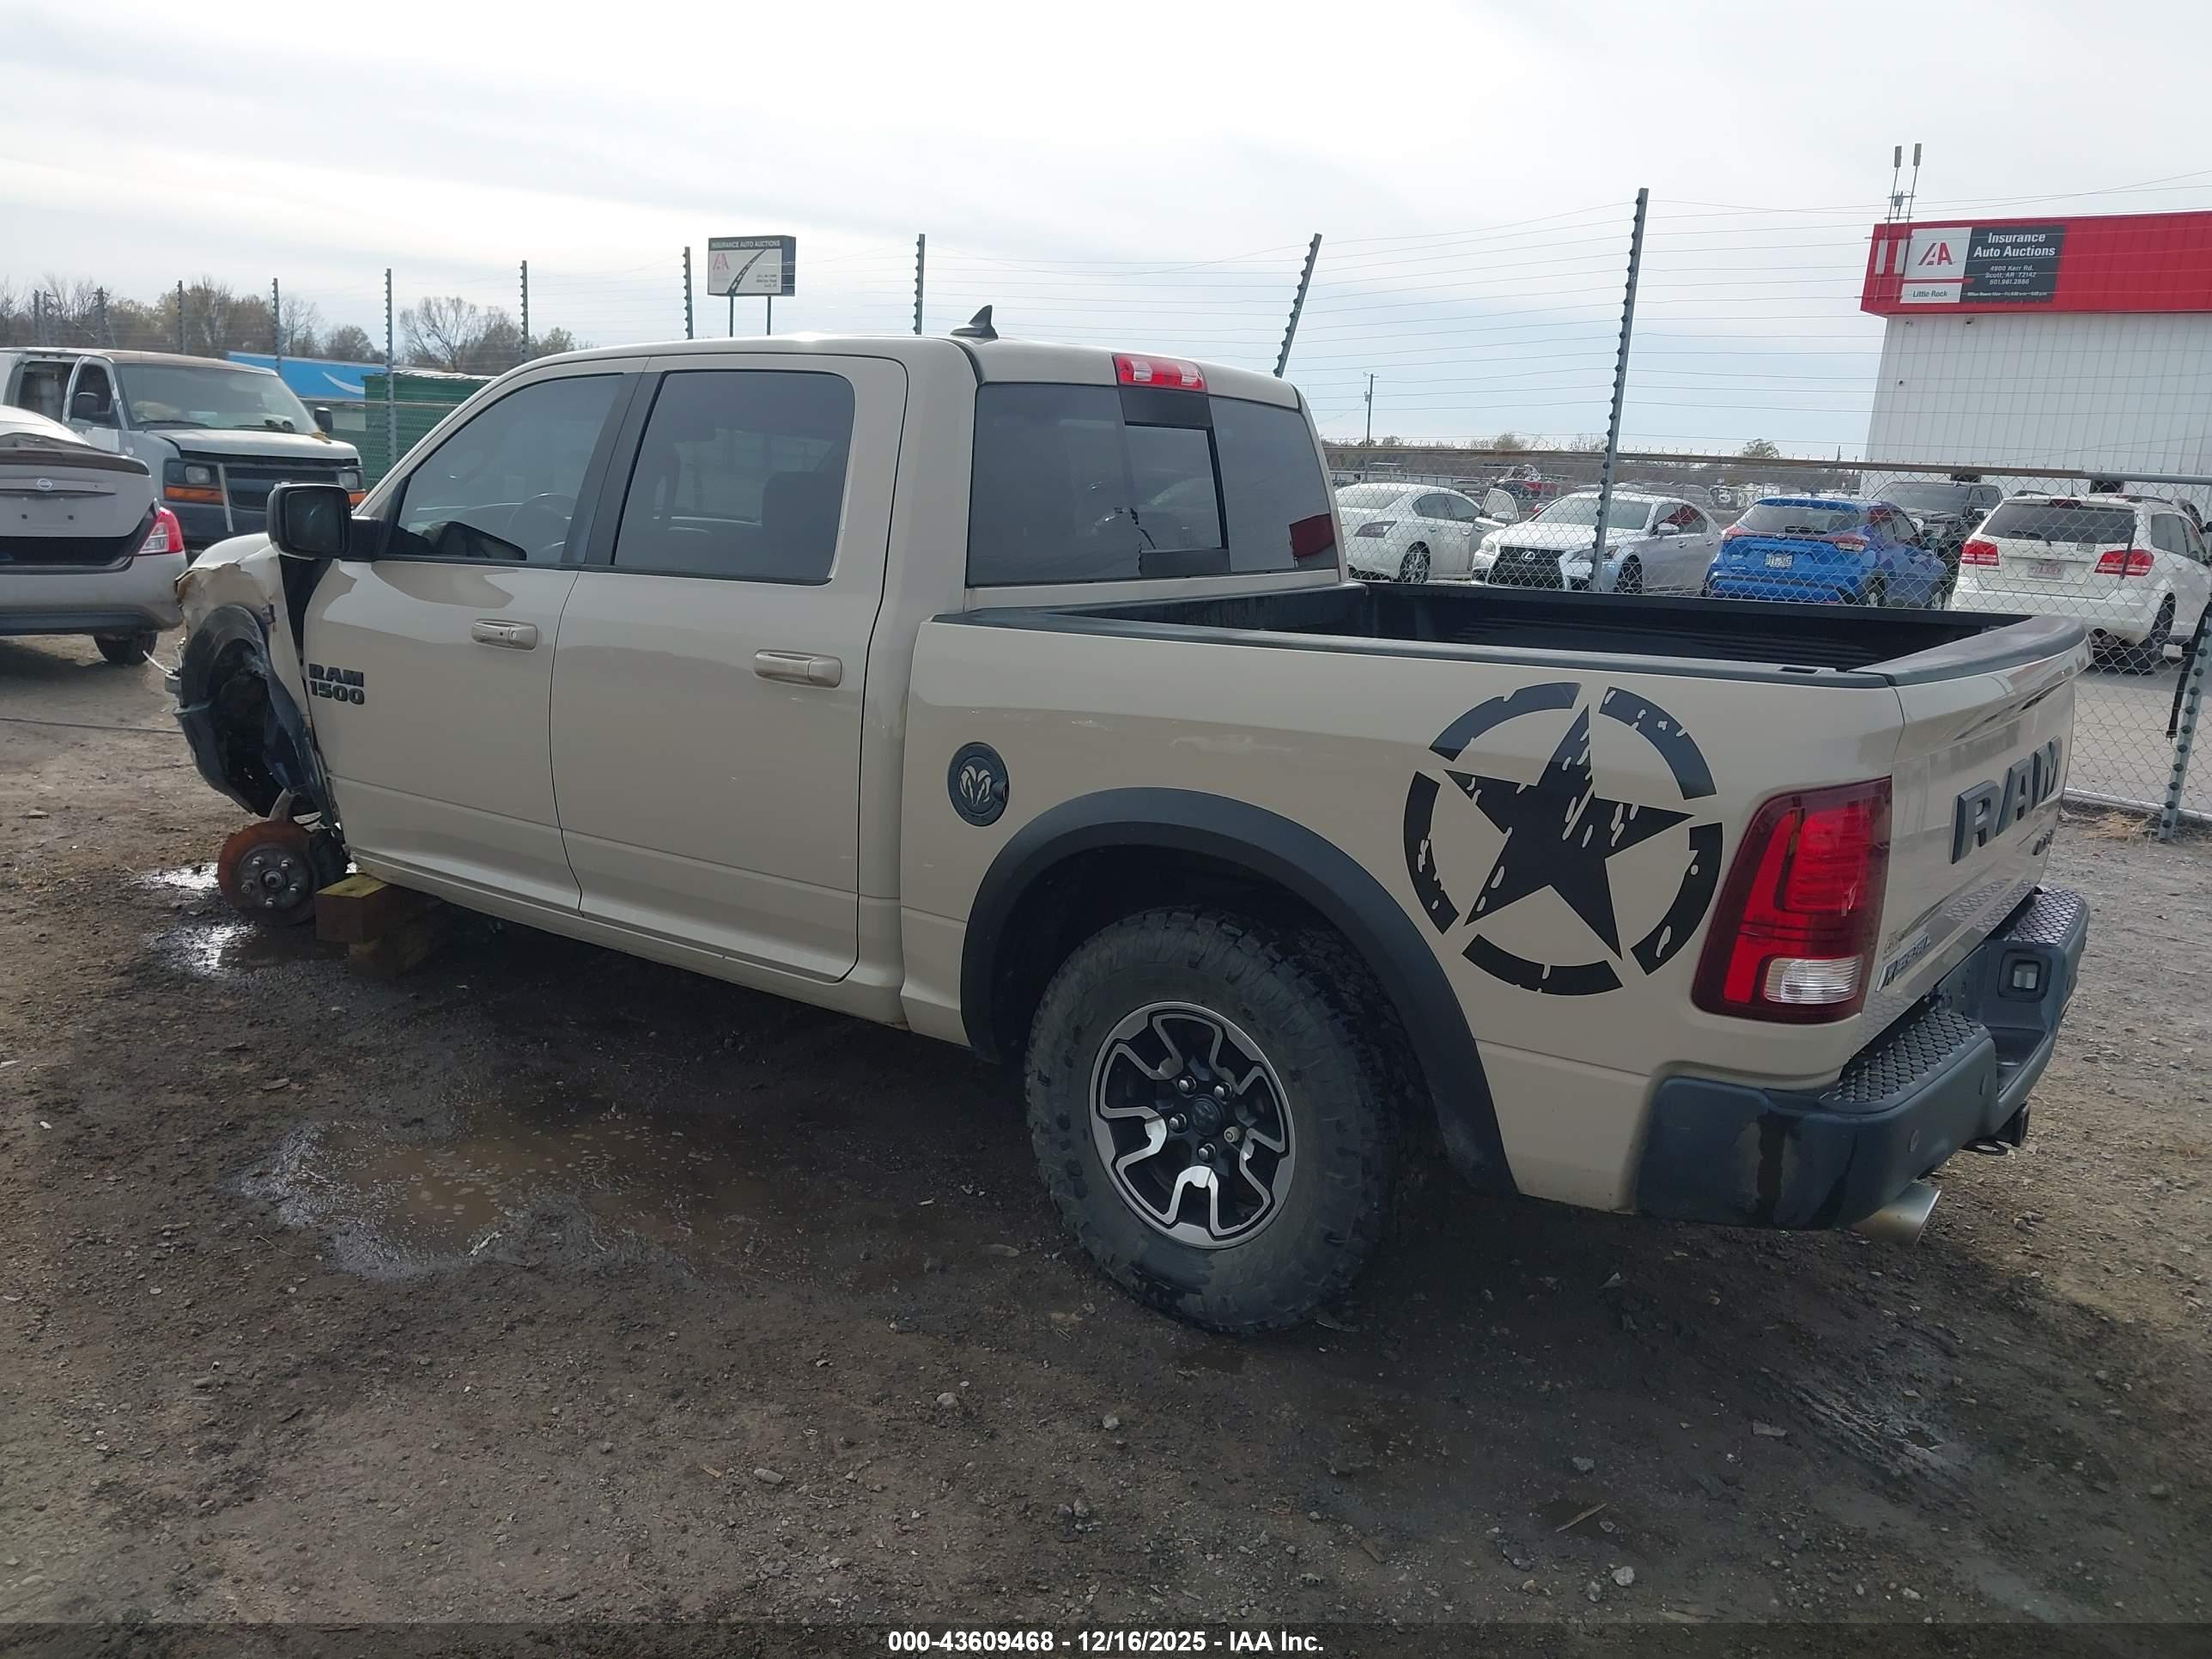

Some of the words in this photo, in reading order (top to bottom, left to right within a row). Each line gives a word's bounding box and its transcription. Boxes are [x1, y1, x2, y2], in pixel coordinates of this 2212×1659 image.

[1988, 233, 2046, 244] Insurance
[1973, 246, 2001, 258] Auto
[2003, 245, 2056, 257] Auctions
[1912, 289, 1930, 298] Little
[309, 663, 364, 688] RAM
[309, 680, 365, 705] 1500
[1951, 735, 2063, 866] RAM
